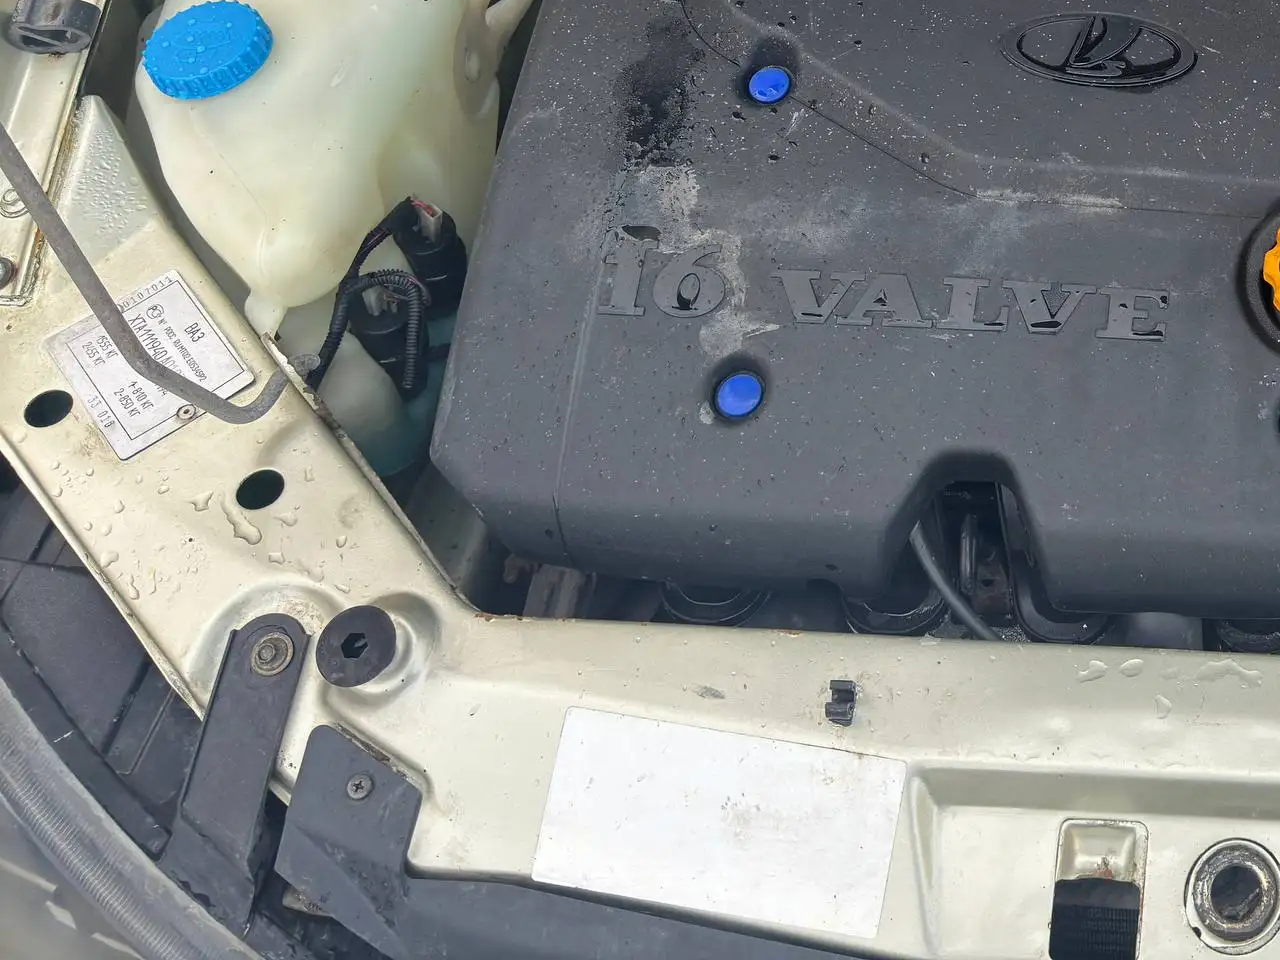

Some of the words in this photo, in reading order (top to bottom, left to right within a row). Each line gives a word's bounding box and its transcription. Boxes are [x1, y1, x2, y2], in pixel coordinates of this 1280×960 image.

[597, 236, 727, 318] 16
[771, 270, 1171, 342] VALVE
[184, 322, 205, 343] ВАЗ
